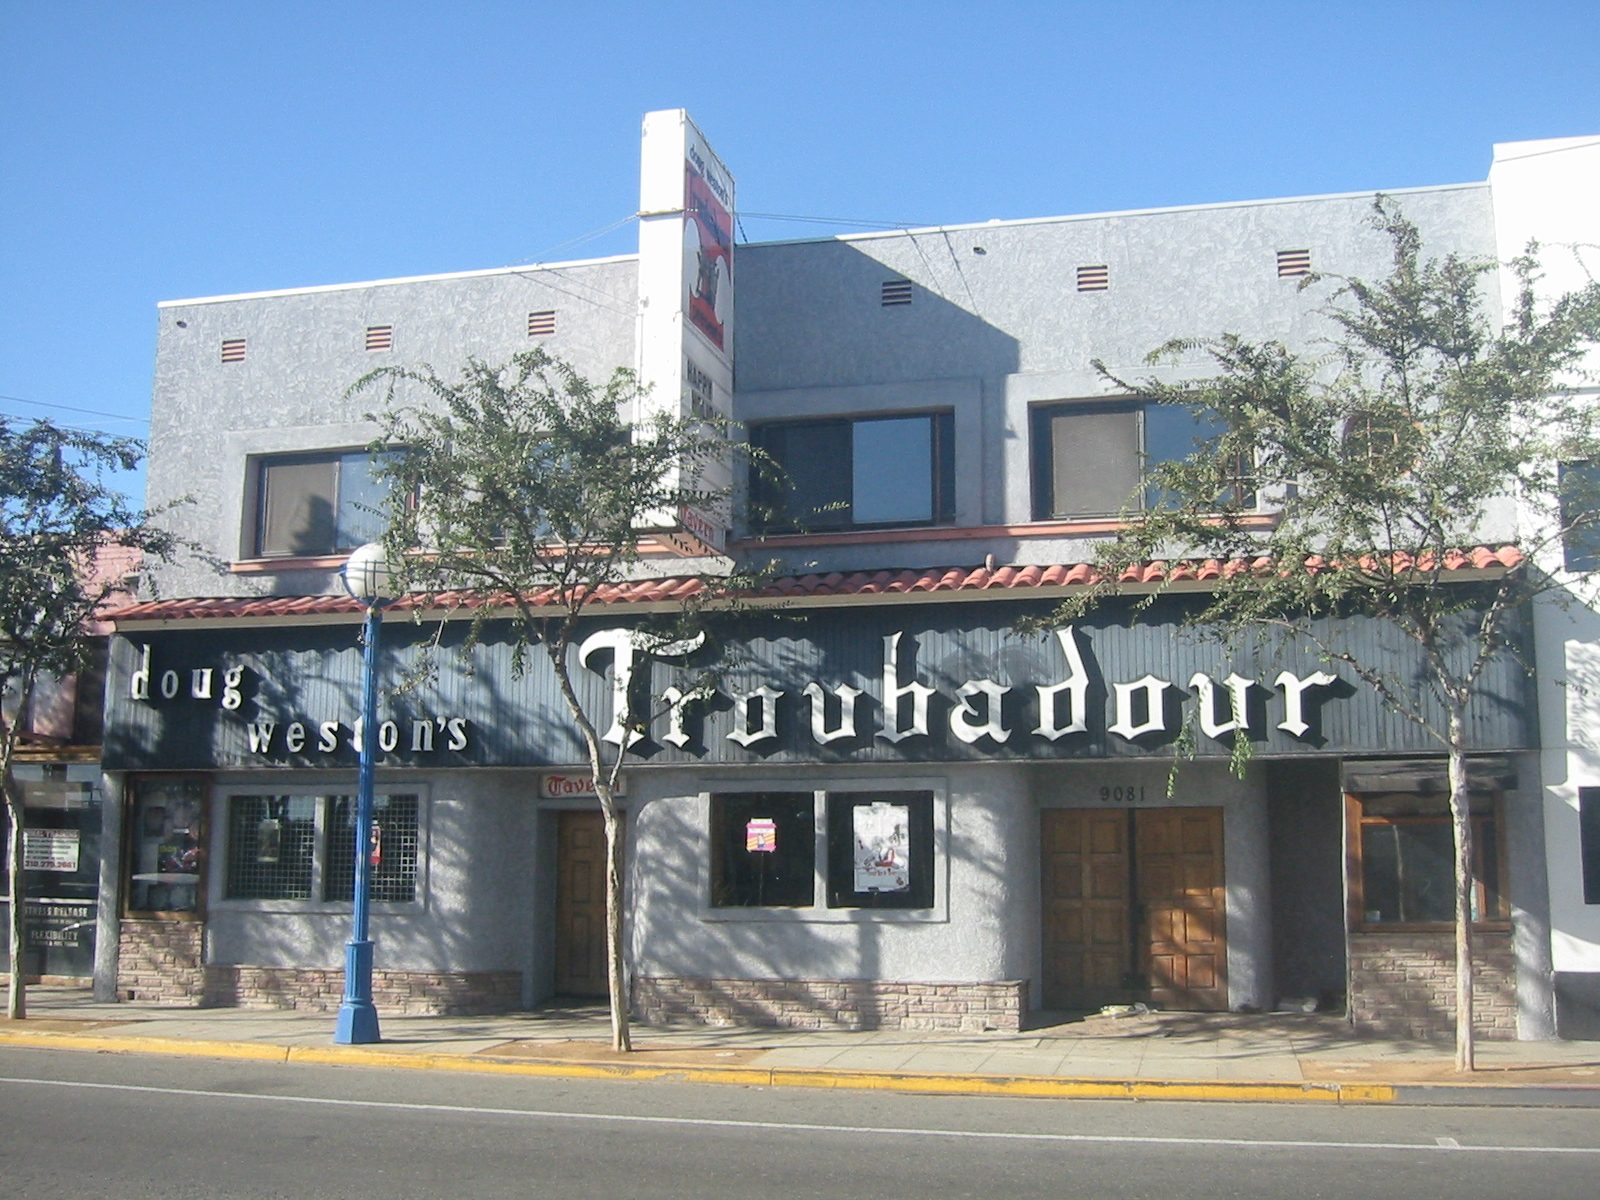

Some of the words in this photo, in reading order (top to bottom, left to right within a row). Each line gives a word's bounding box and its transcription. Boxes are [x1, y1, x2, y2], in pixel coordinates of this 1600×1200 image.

[130, 643, 245, 711] doug
[578, 625, 1338, 749] Troubadour
[1099, 786, 1146, 801] 9081
